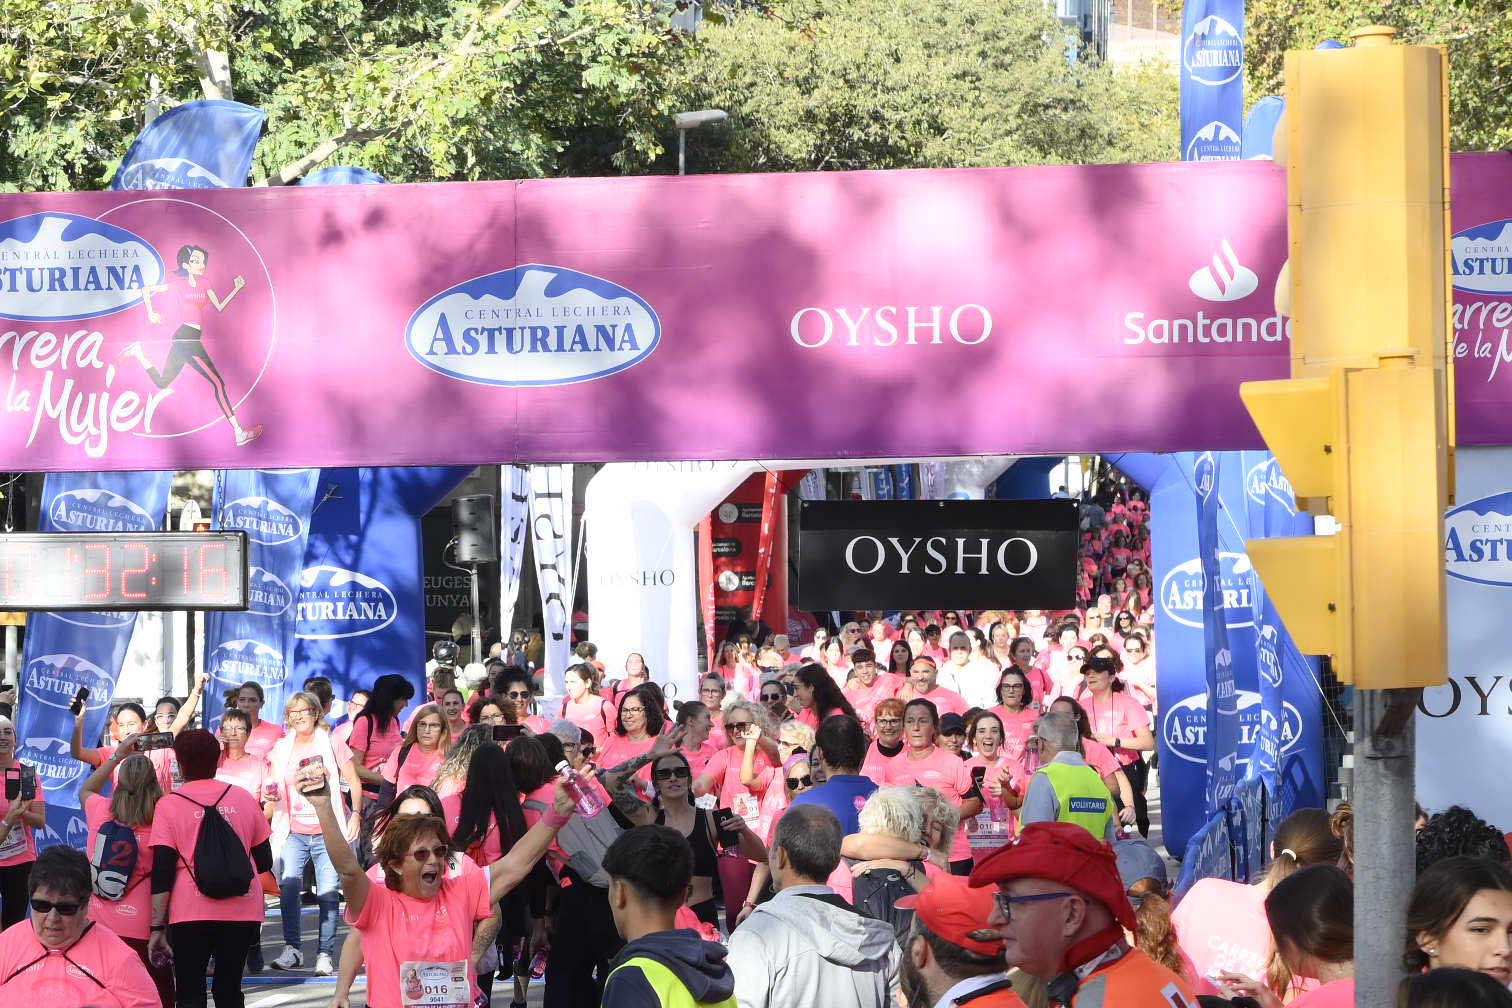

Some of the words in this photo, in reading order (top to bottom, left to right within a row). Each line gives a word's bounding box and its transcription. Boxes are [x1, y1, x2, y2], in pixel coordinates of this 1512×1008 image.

[68, 248, 140, 260] LECHERA
[465, 308, 544, 320] CENTRAL
[552, 305, 632, 318] LECHERA
[790, 303, 993, 348] OYSHO
[425, 311, 641, 356] ASTURIANA
[1474, 330, 1492, 358] la
[5, 373, 31, 412] la
[25, 363, 175, 458] Mujer
[224, 509, 295, 537] ASTURIANA
[845, 535, 1038, 577] OYSHO
[299, 591, 330, 600] NTRAL
[334, 590, 383, 600] LECHERA
[296, 601, 388, 621] TURIANA
[425, 984, 448, 994] 016
